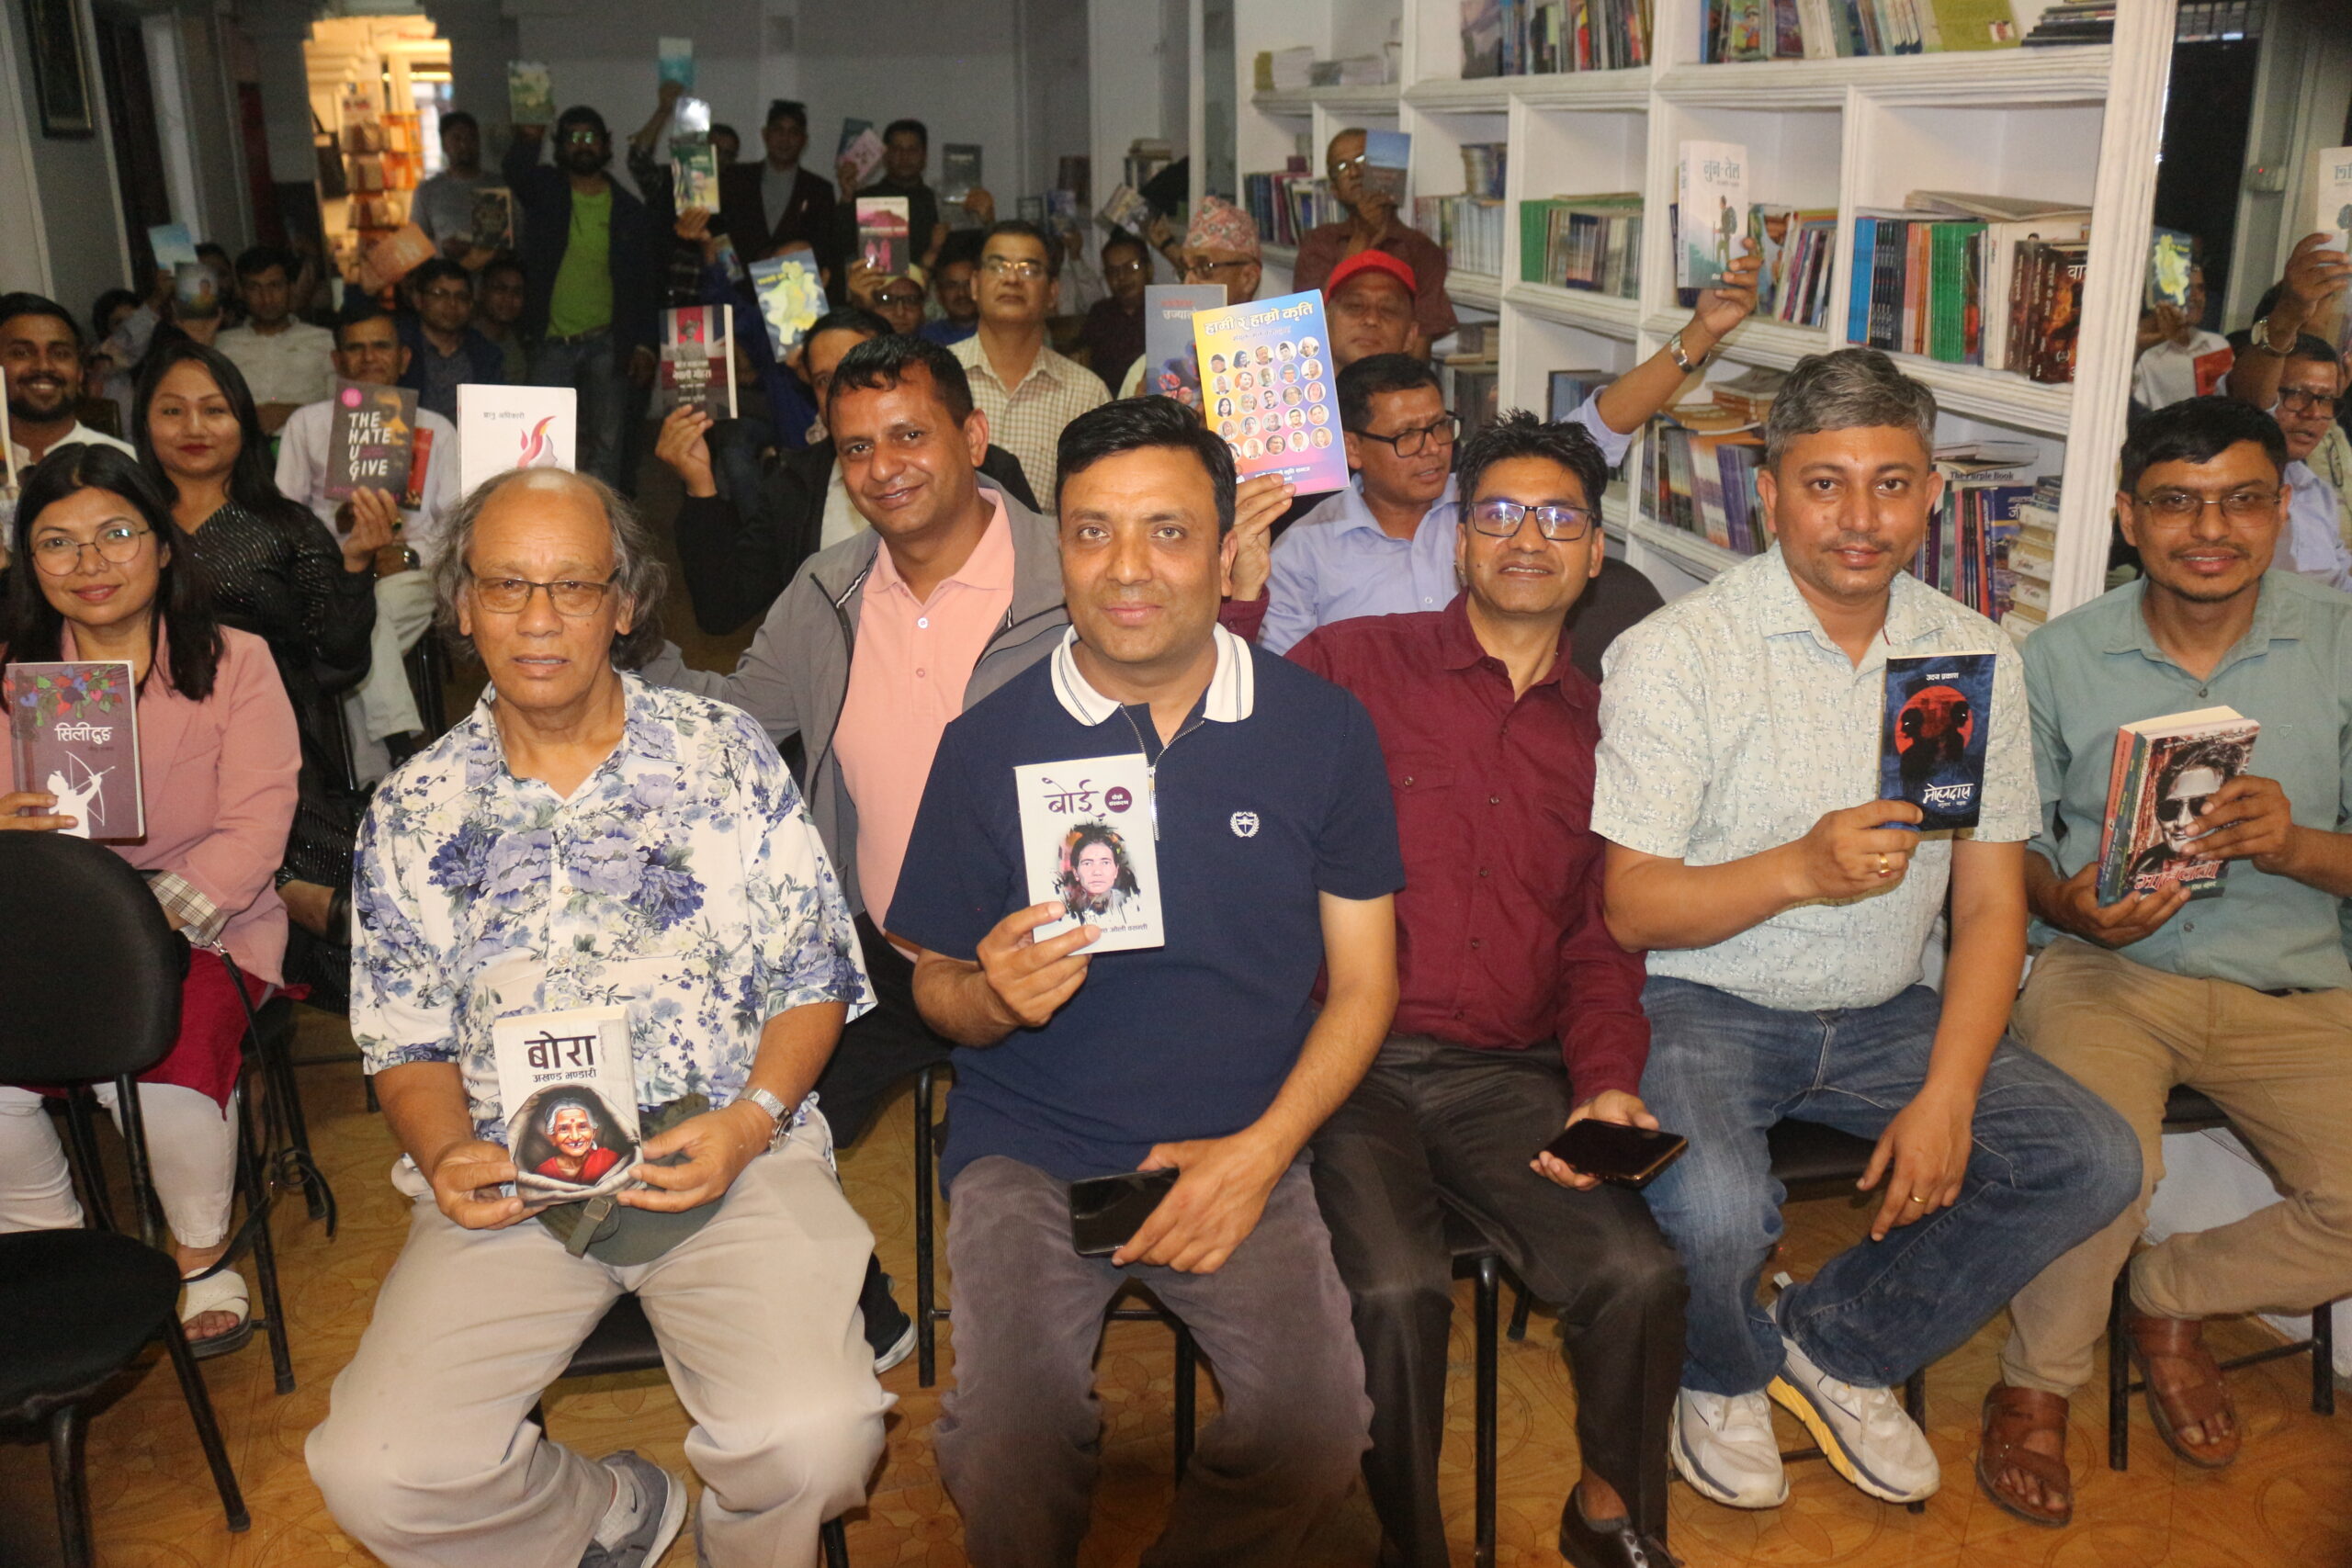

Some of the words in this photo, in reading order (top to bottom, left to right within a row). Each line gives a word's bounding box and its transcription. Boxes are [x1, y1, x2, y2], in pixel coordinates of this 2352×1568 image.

[1204, 317, 1234, 336] हामी
[1250, 308, 1280, 326] हाम्रो
[1283, 301, 1315, 322] कृति
[348, 412, 381, 428] THE
[348, 427, 392, 445] HATE
[348, 445, 360, 460] U
[348, 459, 389, 482] GIVE
[1994, 471, 2014, 479] Book
[1923, 783, 1974, 804] मोहनदास
[524, 1031, 597, 1069] बोरा
[532, 1073, 562, 1083] अखण्ड
[565, 1068, 597, 1080] भण्डारी
